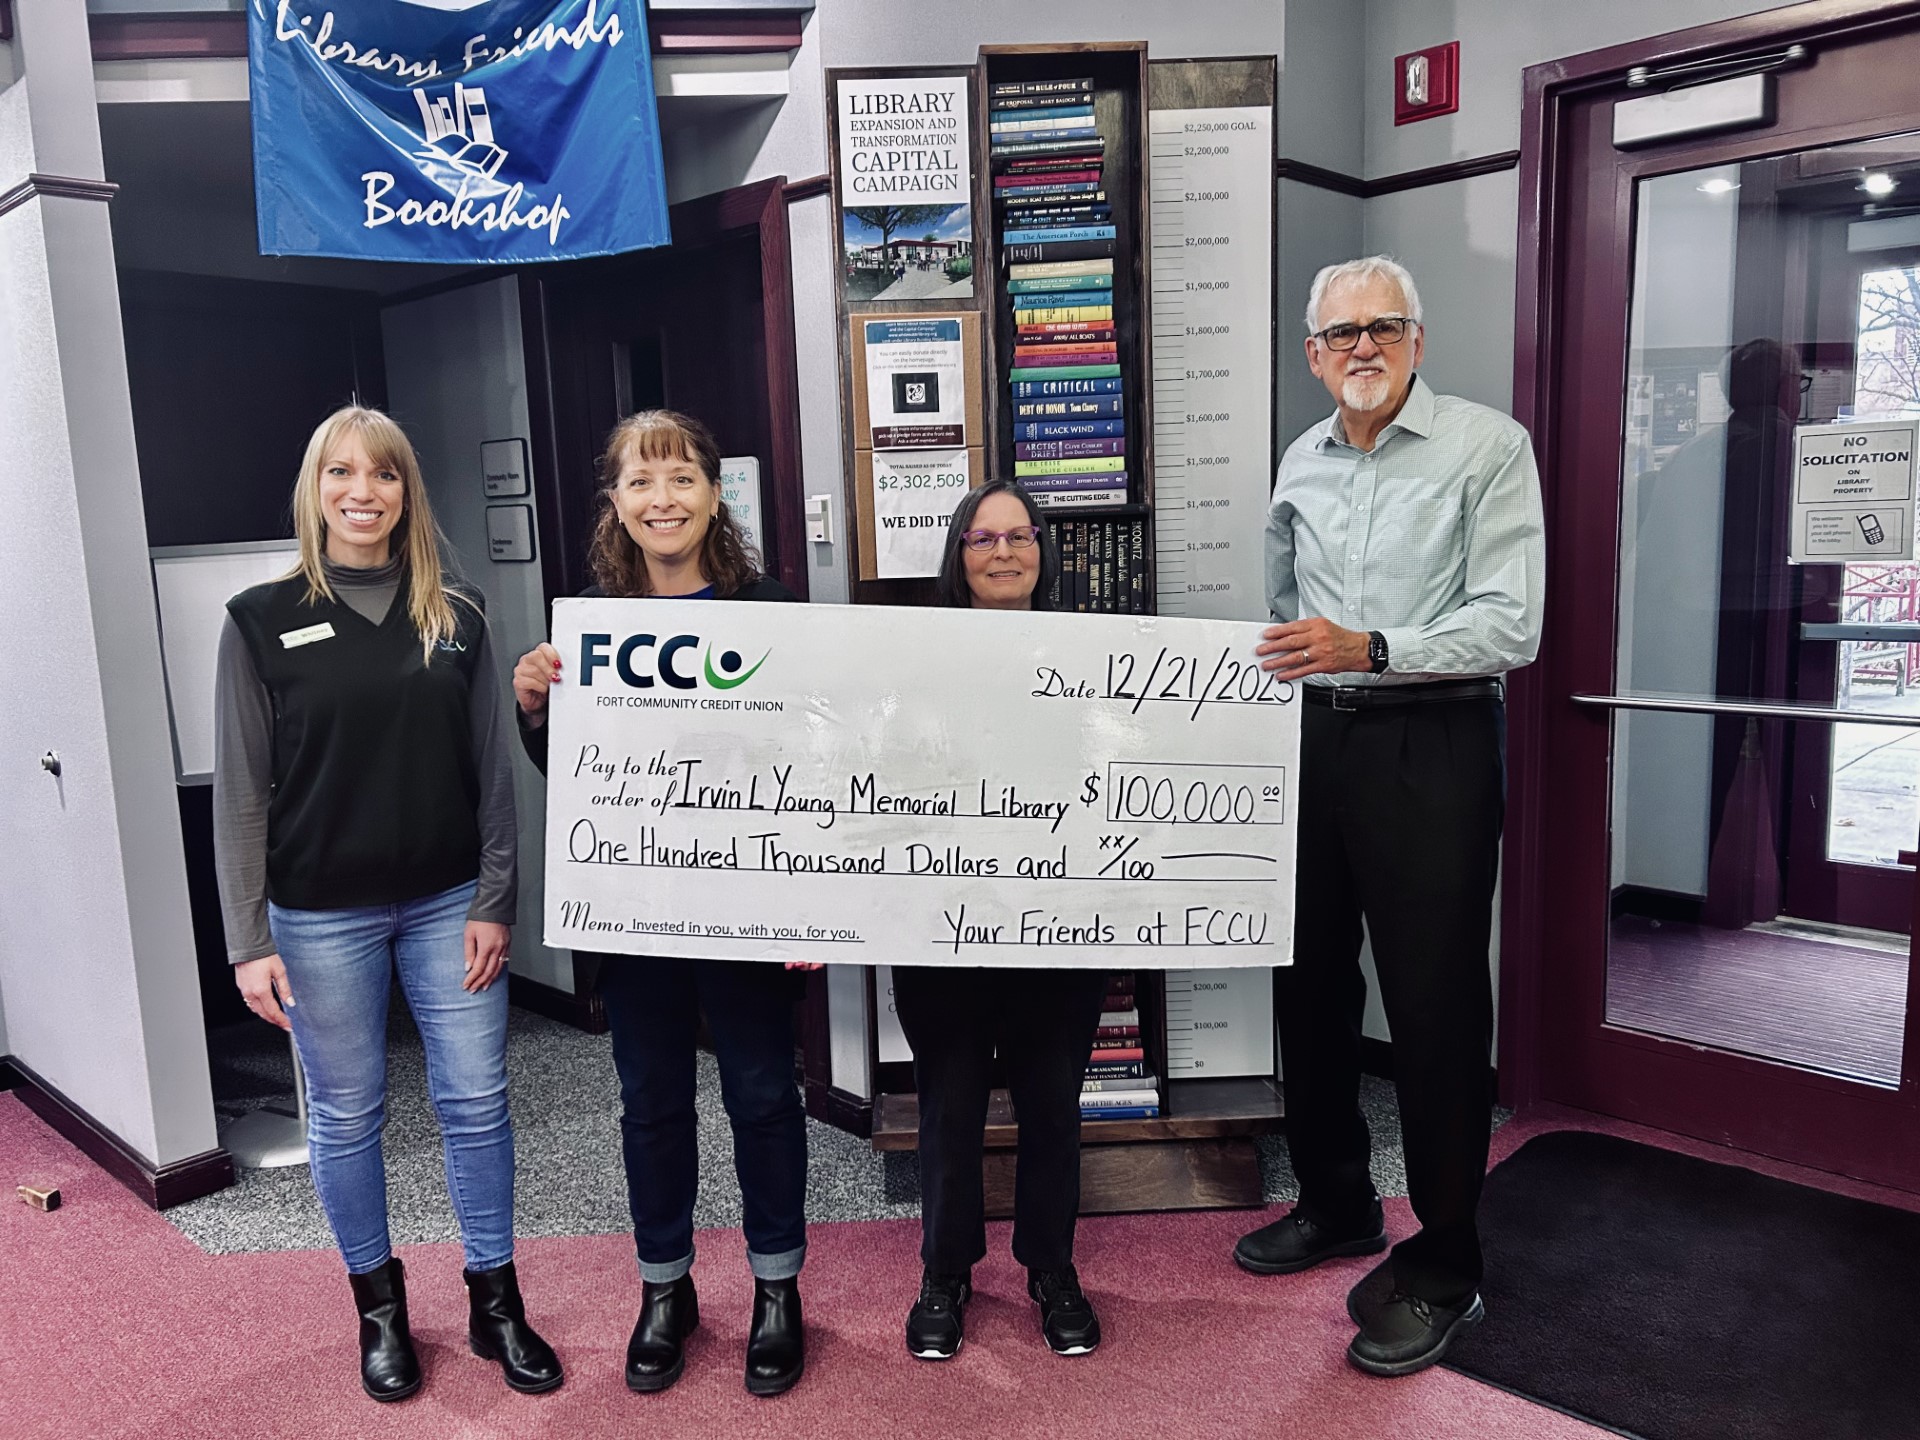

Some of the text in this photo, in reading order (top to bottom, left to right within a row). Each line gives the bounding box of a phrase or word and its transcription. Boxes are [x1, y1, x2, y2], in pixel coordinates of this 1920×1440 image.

[276, 0, 624, 87] Library Friends
[849, 92, 955, 115] LIBRARY
[850, 118, 956, 131] EXPANSION AND
[1184, 122, 1256, 132] $2,250,000 GOAL
[851, 134, 957, 148] TRANSFORMATION
[1184, 146, 1229, 156] $2,200,000
[852, 150, 958, 172] CAPITAL
[854, 174, 958, 192] CAMPAIGN
[1185, 192, 1229, 201] $2,100,000
[361, 171, 570, 245] Bookshop
[1036, 232, 1068, 240] American
[1185, 236, 1229, 246] $2,000,000
[1186, 282, 1229, 291] $1,900,000
[1186, 326, 1229, 336] $1,800,000
[1186, 370, 1229, 379] $1,700,000
[1043, 381, 1096, 394] CRITICAL
[1020, 402, 1098, 416] DEBT OF HONOR Tom Clancy
[1186, 413, 1229, 423] $1,600,000
[1044, 426, 1068, 434] BLACK
[1026, 442, 1056, 450] ARCTIC
[1844, 436, 1867, 447] NO
[1031, 450, 1056, 458] DRIFT
[1802, 451, 1909, 466] SOLICITATION
[1186, 456, 1230, 466] $1,500,000
[878, 473, 965, 492] $2,302,509
[1066, 494, 1092, 502] CUTTING
[1187, 500, 1230, 509] $1,400,000
[882, 514, 954, 529] WE DID IT
[1132, 525, 1142, 560] KOONTZ
[1187, 542, 1230, 551] $1,300,000
[1187, 584, 1230, 592] $1,200,000
[1032, 667, 1095, 698] Date
[597, 696, 784, 712] FORT COMMUNITY CREDIT UNION
[574, 744, 678, 782] Pay to the
[1080, 772, 1101, 808] $
[591, 780, 678, 816] order of
[675, 760, 1070, 834] Irvin L Young Memorial Library
[570, 818, 629, 864] One
[640, 826, 738, 870] Hundred
[748, 833, 885, 876] Thousand
[906, 843, 999, 876] Dollars
[1016, 845, 1066, 880] and
[561, 900, 860, 942] Memo Invested in you, with you, for you.
[944, 904, 1266, 954] Your Friends at FCCU
[1194, 983, 1227, 991] $200,000
[1194, 1022, 1228, 1030] $100,000
[1194, 1060, 1204, 1068] $0
